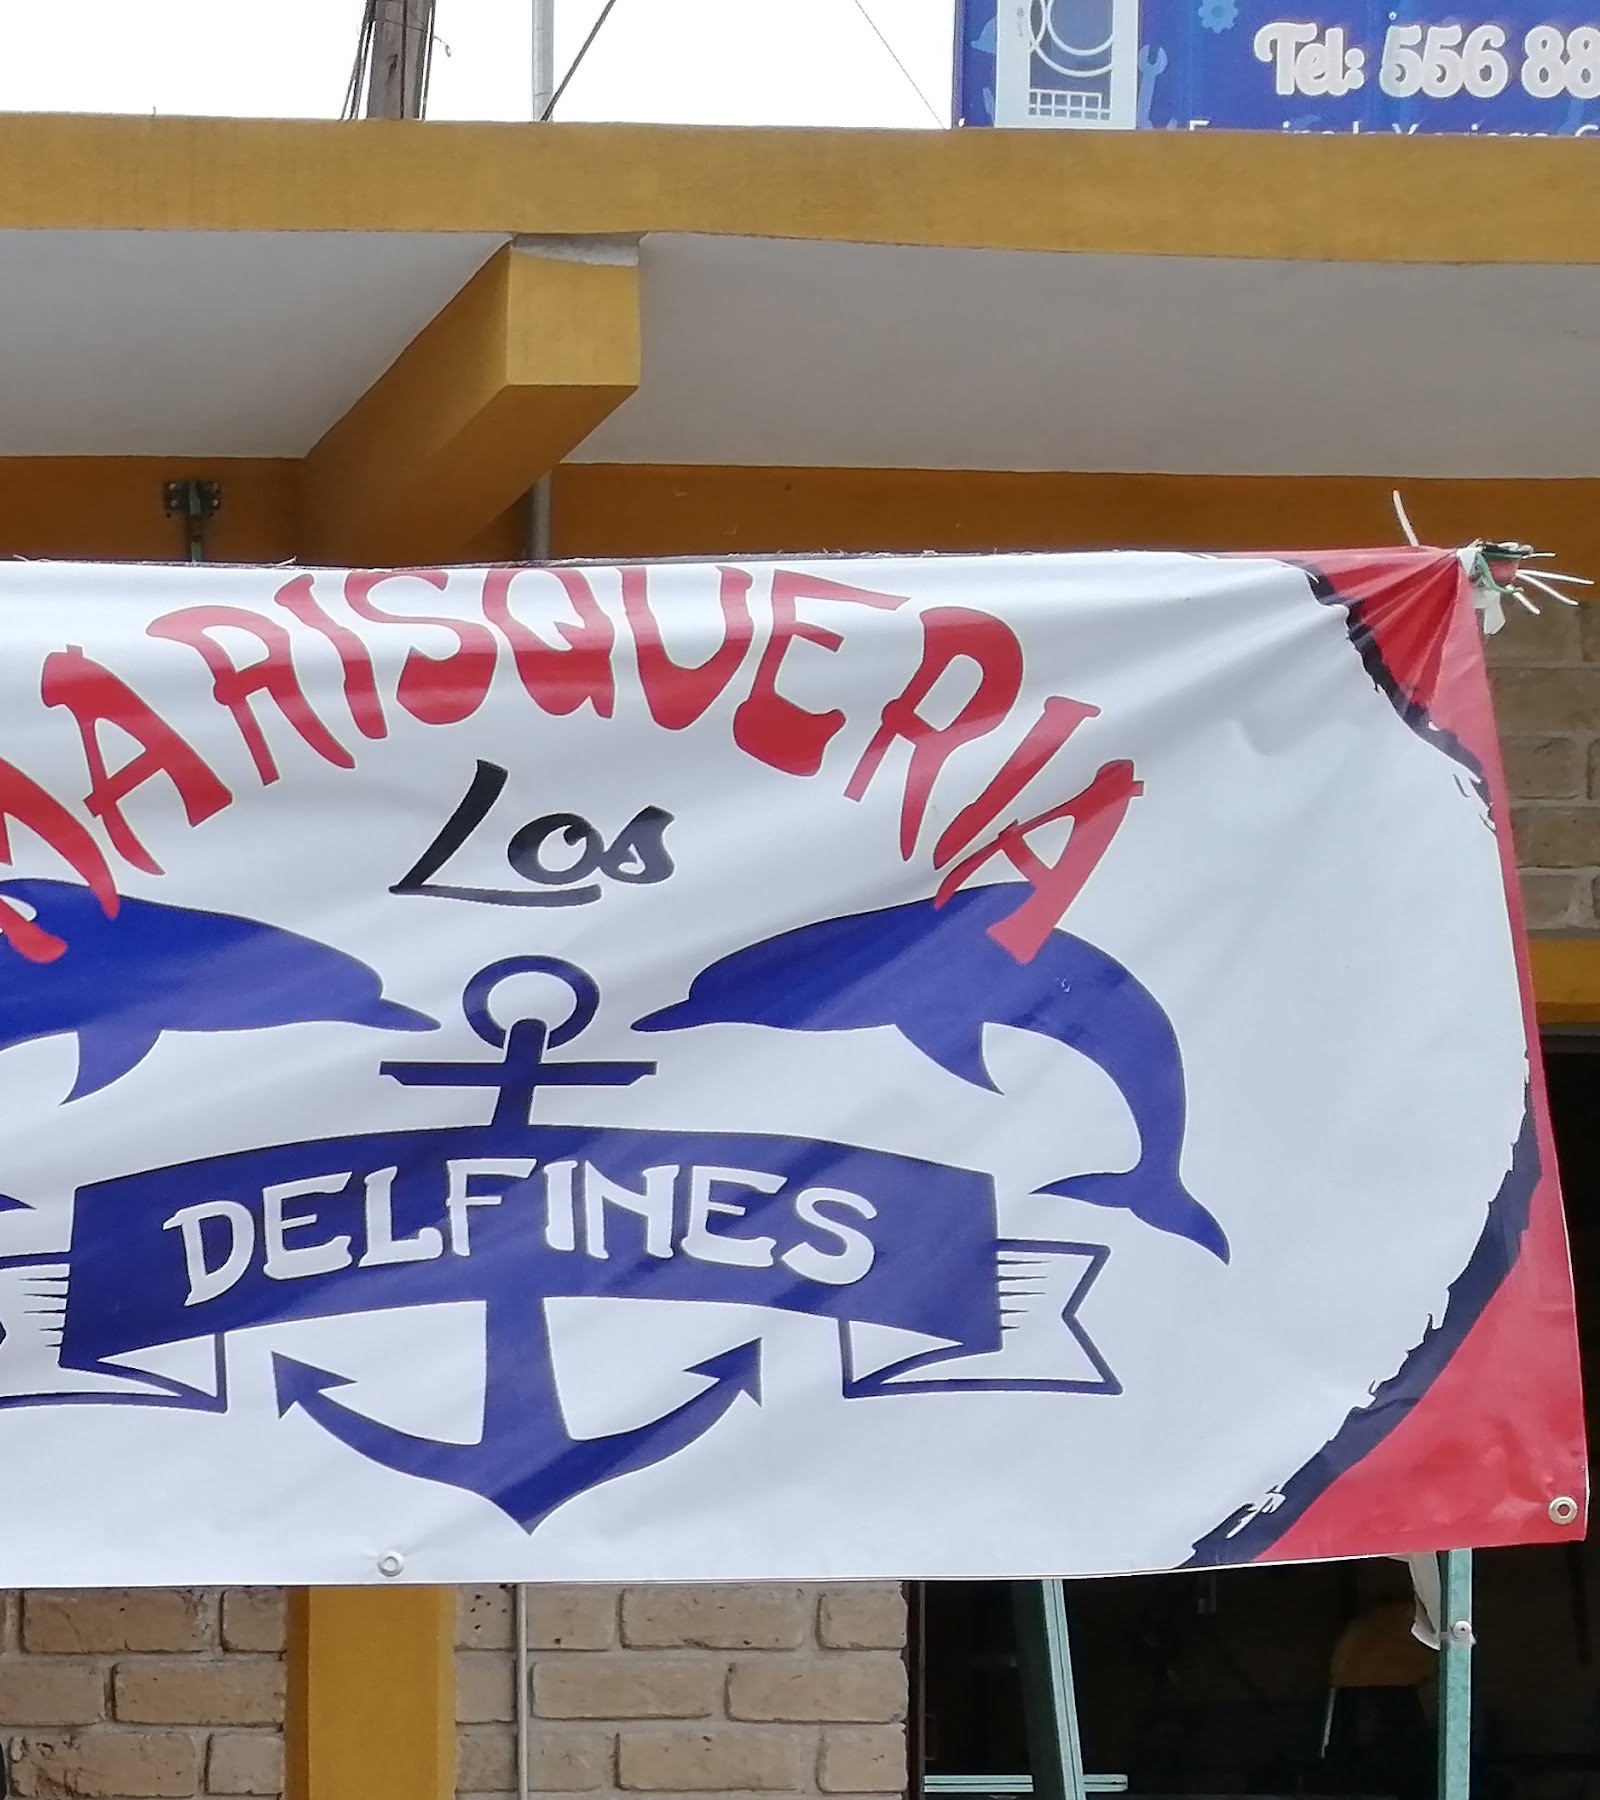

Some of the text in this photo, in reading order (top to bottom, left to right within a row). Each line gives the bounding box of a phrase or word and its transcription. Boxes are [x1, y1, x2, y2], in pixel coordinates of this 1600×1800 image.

[1253, 22, 1366, 96] Tel:
[1379, 24, 1509, 98] 556
[388, 759, 676, 907] Los
[162, 1156, 878, 1309] DELFINES
